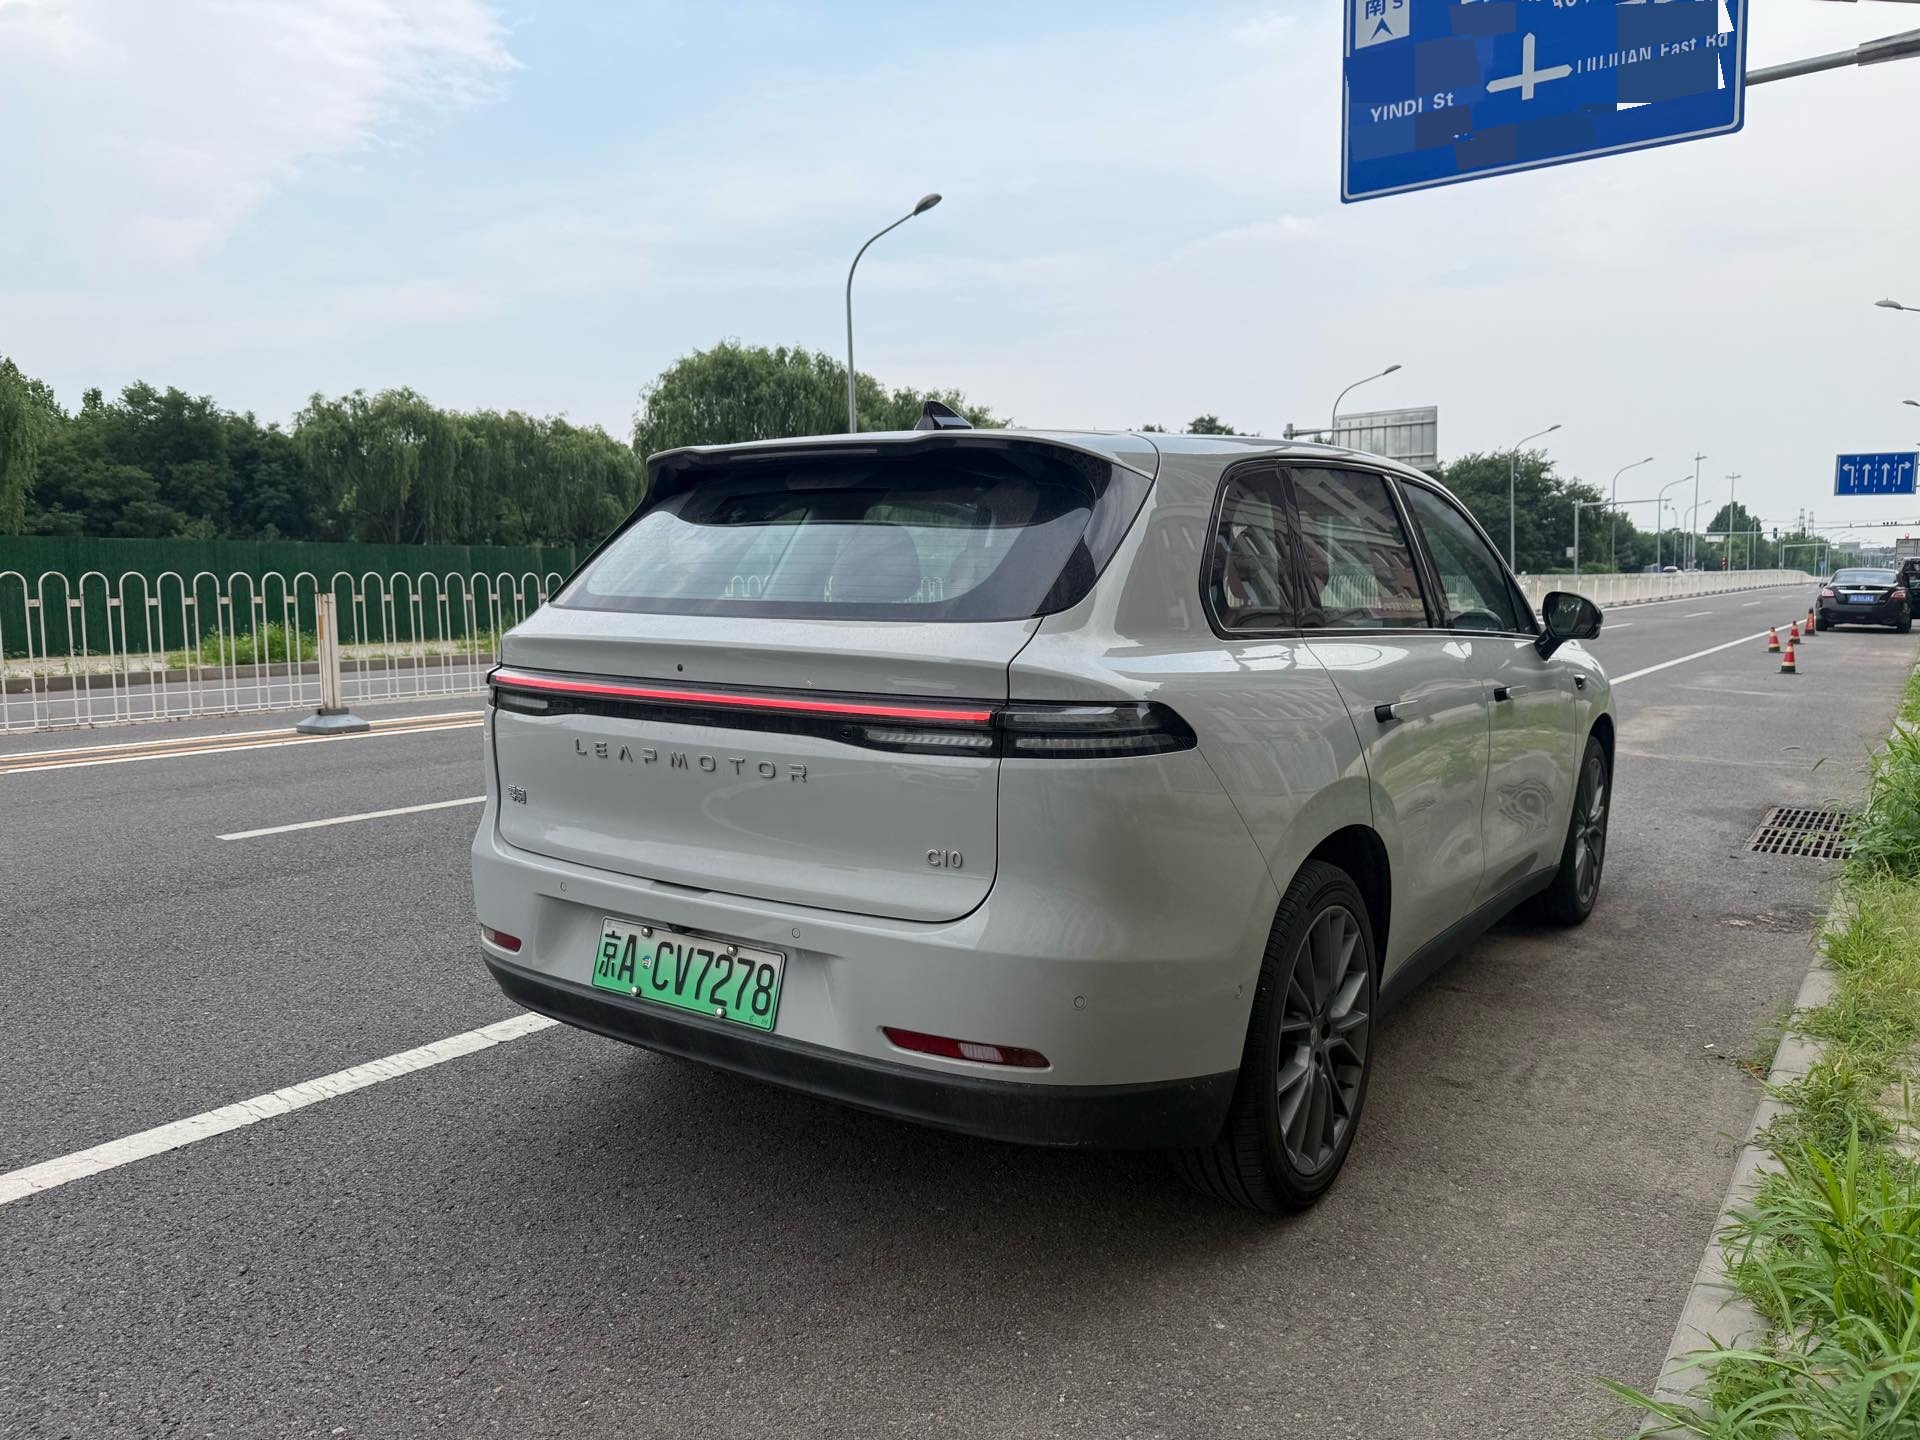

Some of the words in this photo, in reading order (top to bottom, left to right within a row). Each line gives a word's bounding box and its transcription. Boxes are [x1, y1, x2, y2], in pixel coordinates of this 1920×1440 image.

[1370, 97, 1423, 121] YINDI
[1433, 92, 1455, 108] St
[575, 738, 808, 783] LEAPMOTOR
[926, 848, 963, 868] C10
